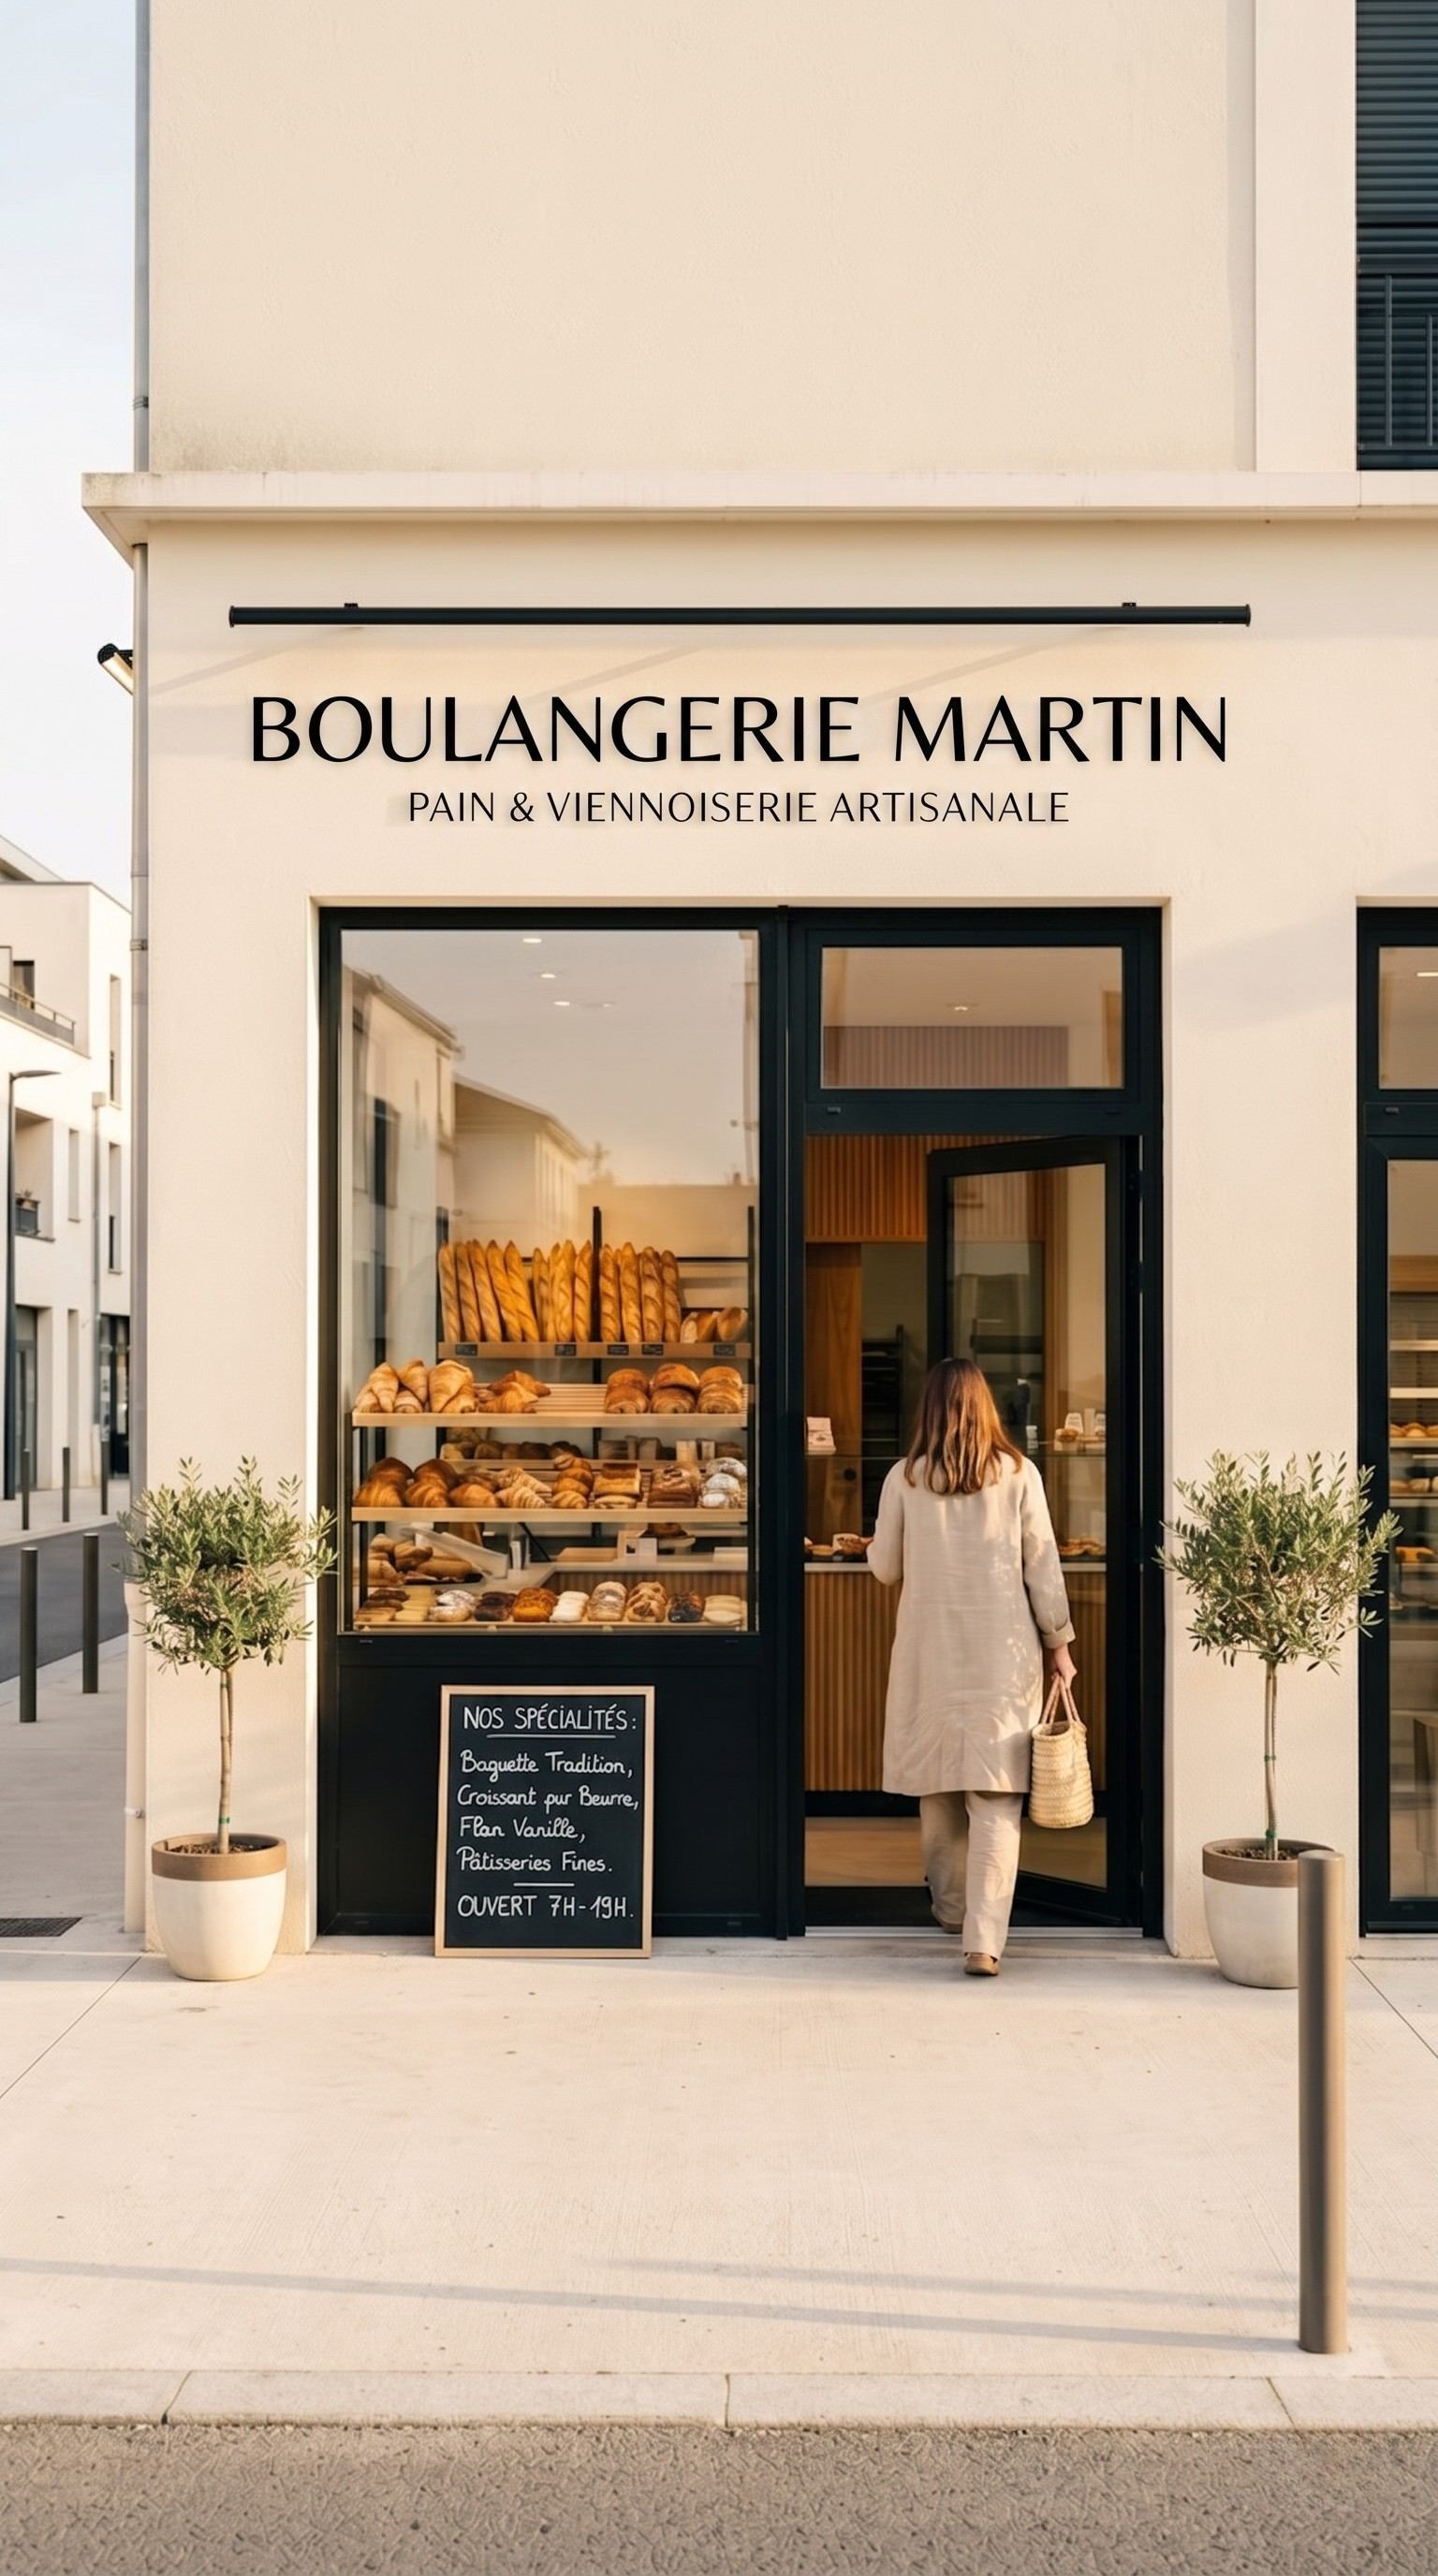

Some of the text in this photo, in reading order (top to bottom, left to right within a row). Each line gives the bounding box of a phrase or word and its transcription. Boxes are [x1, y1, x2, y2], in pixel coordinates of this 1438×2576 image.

[252, 695, 1226, 763] BOULANGERIE MARTIN
[409, 791, 1069, 823] PAIN & VIENNOISERIE ARTISANALE
[463, 1705, 505, 1730] NOS
[460, 1749, 633, 1783] Baguette Tradition,
[457, 1784, 638, 1814] Croissant pur Beurre,
[460, 1815, 586, 1843] Flan Vanille,
[456, 1845, 613, 1872] Pâtisseries Fines.
[457, 1895, 537, 1917] OUVERT
